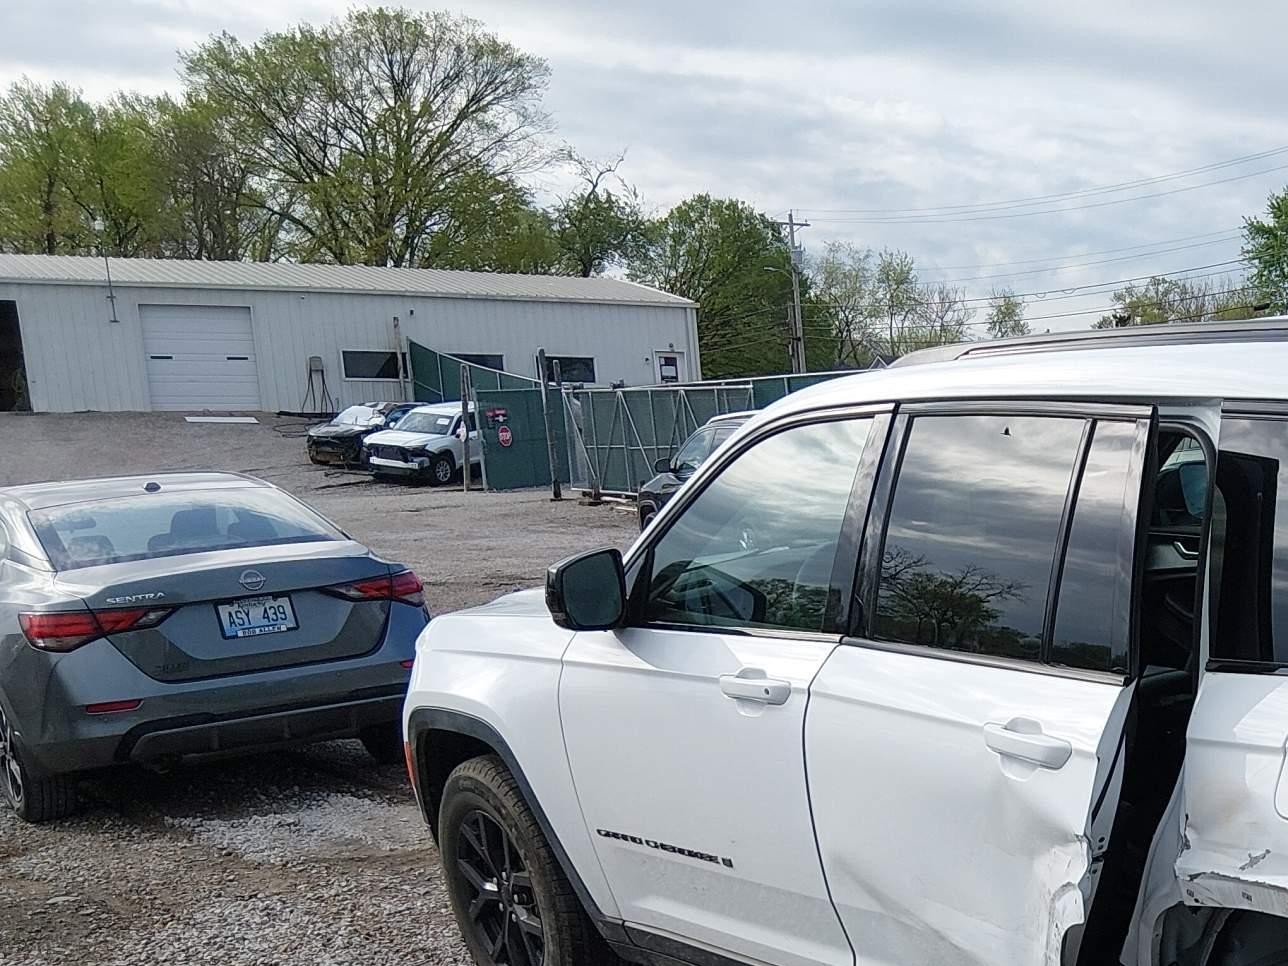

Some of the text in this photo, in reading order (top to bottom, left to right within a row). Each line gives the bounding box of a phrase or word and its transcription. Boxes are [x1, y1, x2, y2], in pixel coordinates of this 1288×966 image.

[106, 592, 165, 604] SENTRA
[228, 604, 288, 628] ASY 439
